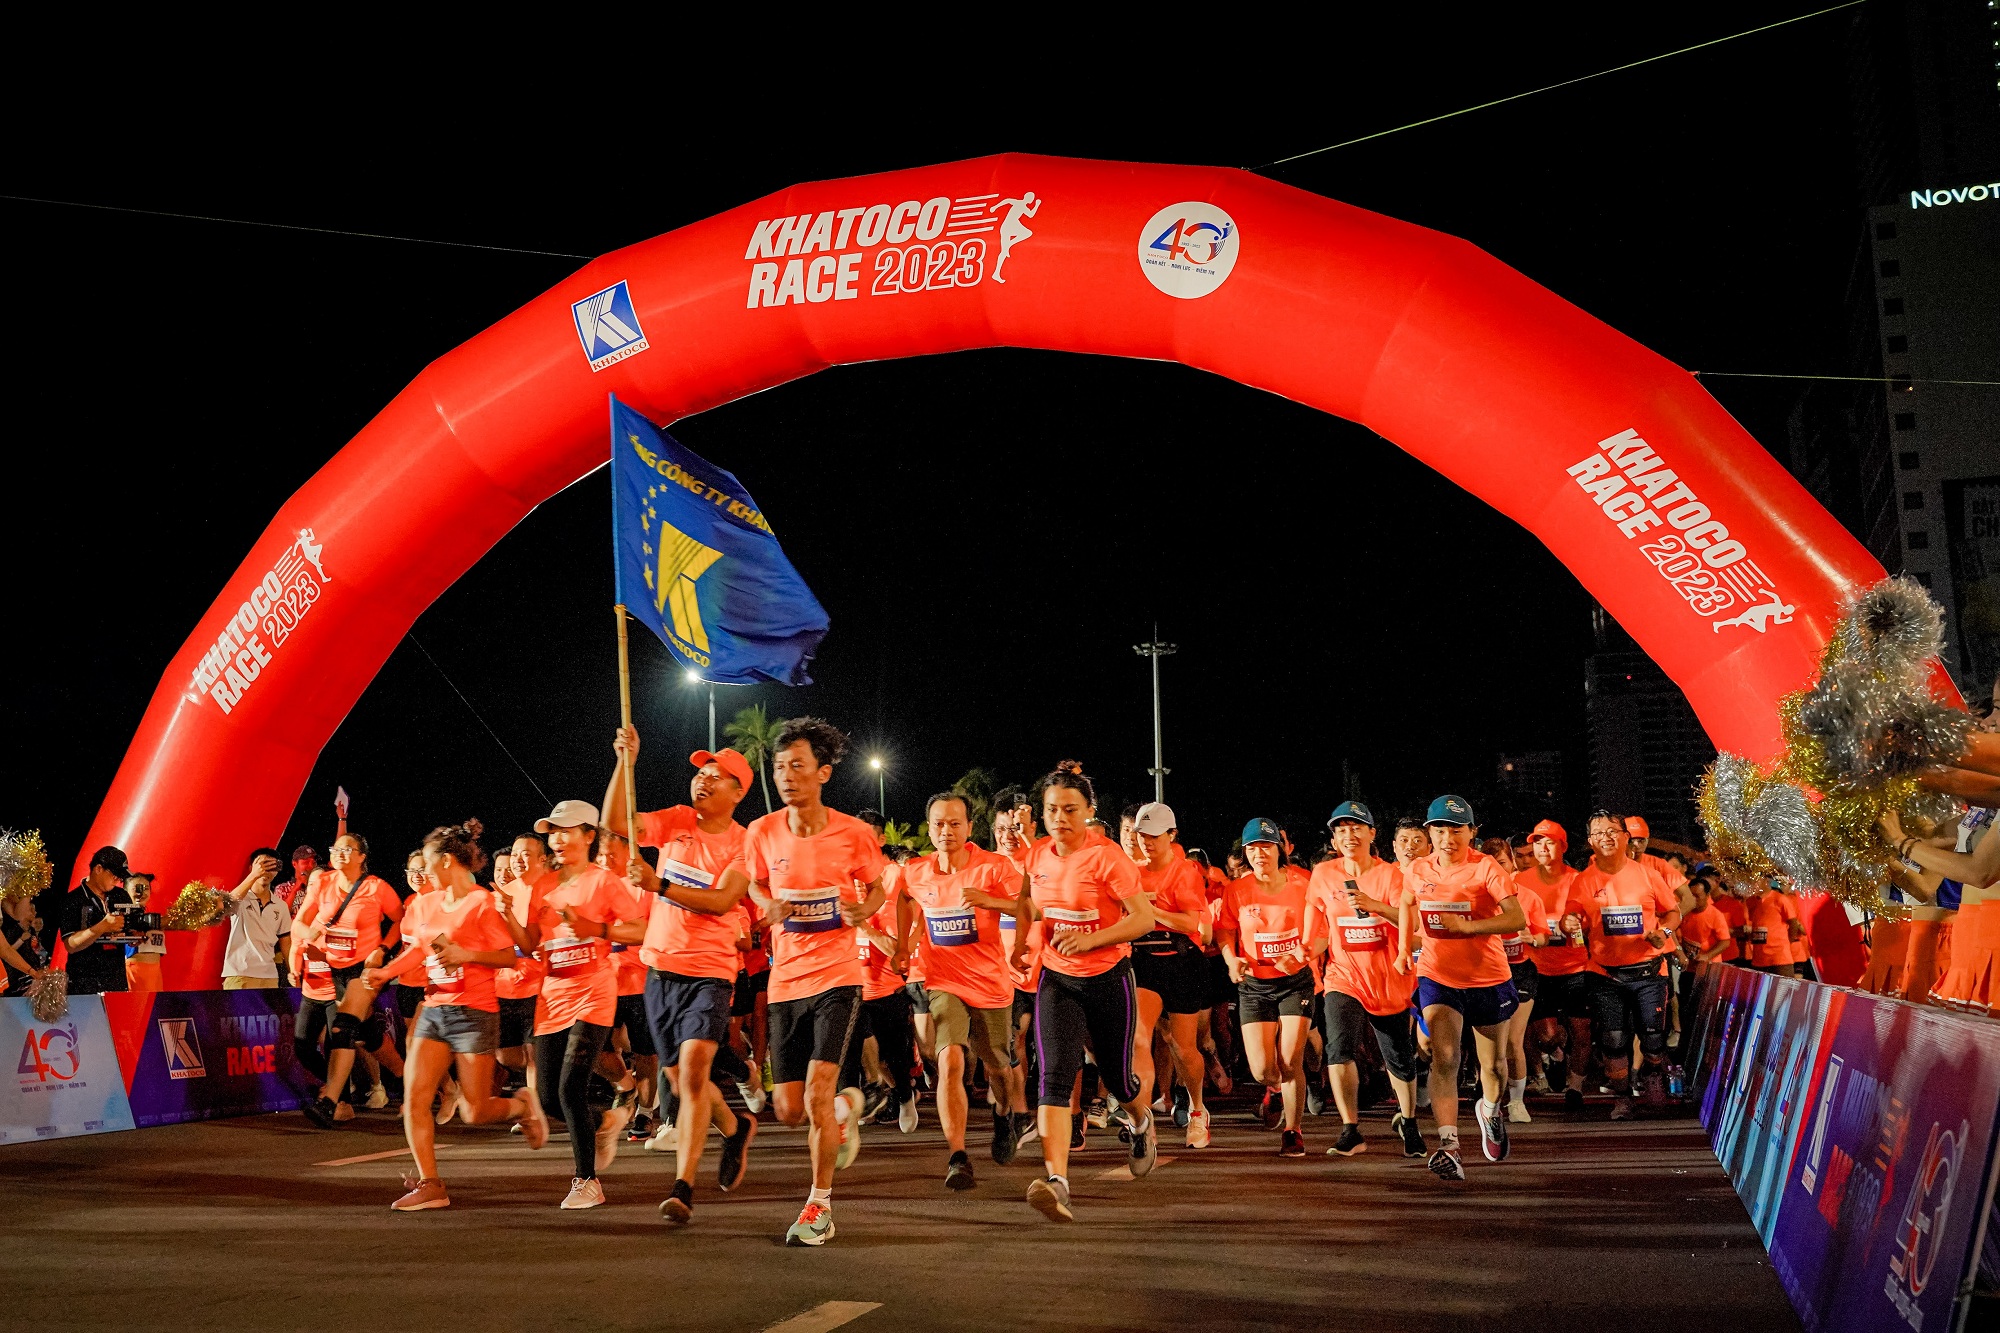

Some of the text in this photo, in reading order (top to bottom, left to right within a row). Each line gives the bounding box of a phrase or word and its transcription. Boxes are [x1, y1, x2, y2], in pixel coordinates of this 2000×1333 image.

[745, 197, 951, 259] KHATOCO
[747, 238, 986, 308] RACE 2023
[592, 341, 647, 371] KHATOCO
[704, 487, 731, 505] TY
[1598, 428, 1746, 568] KHATOCO
[1566, 453, 1734, 616] RACE 2023
[192, 571, 283, 694] KHATOCO
[210, 571, 320, 715] RACE 2023
[931, 919, 969, 931] 790097
[1607, 915, 1639, 924] 790739
[1262, 940, 1296, 953] 680056
[220, 1014, 296, 1042] KHATOC
[171, 1069, 205, 1078] KHATOCO
[227, 1044, 276, 1076] RACE
